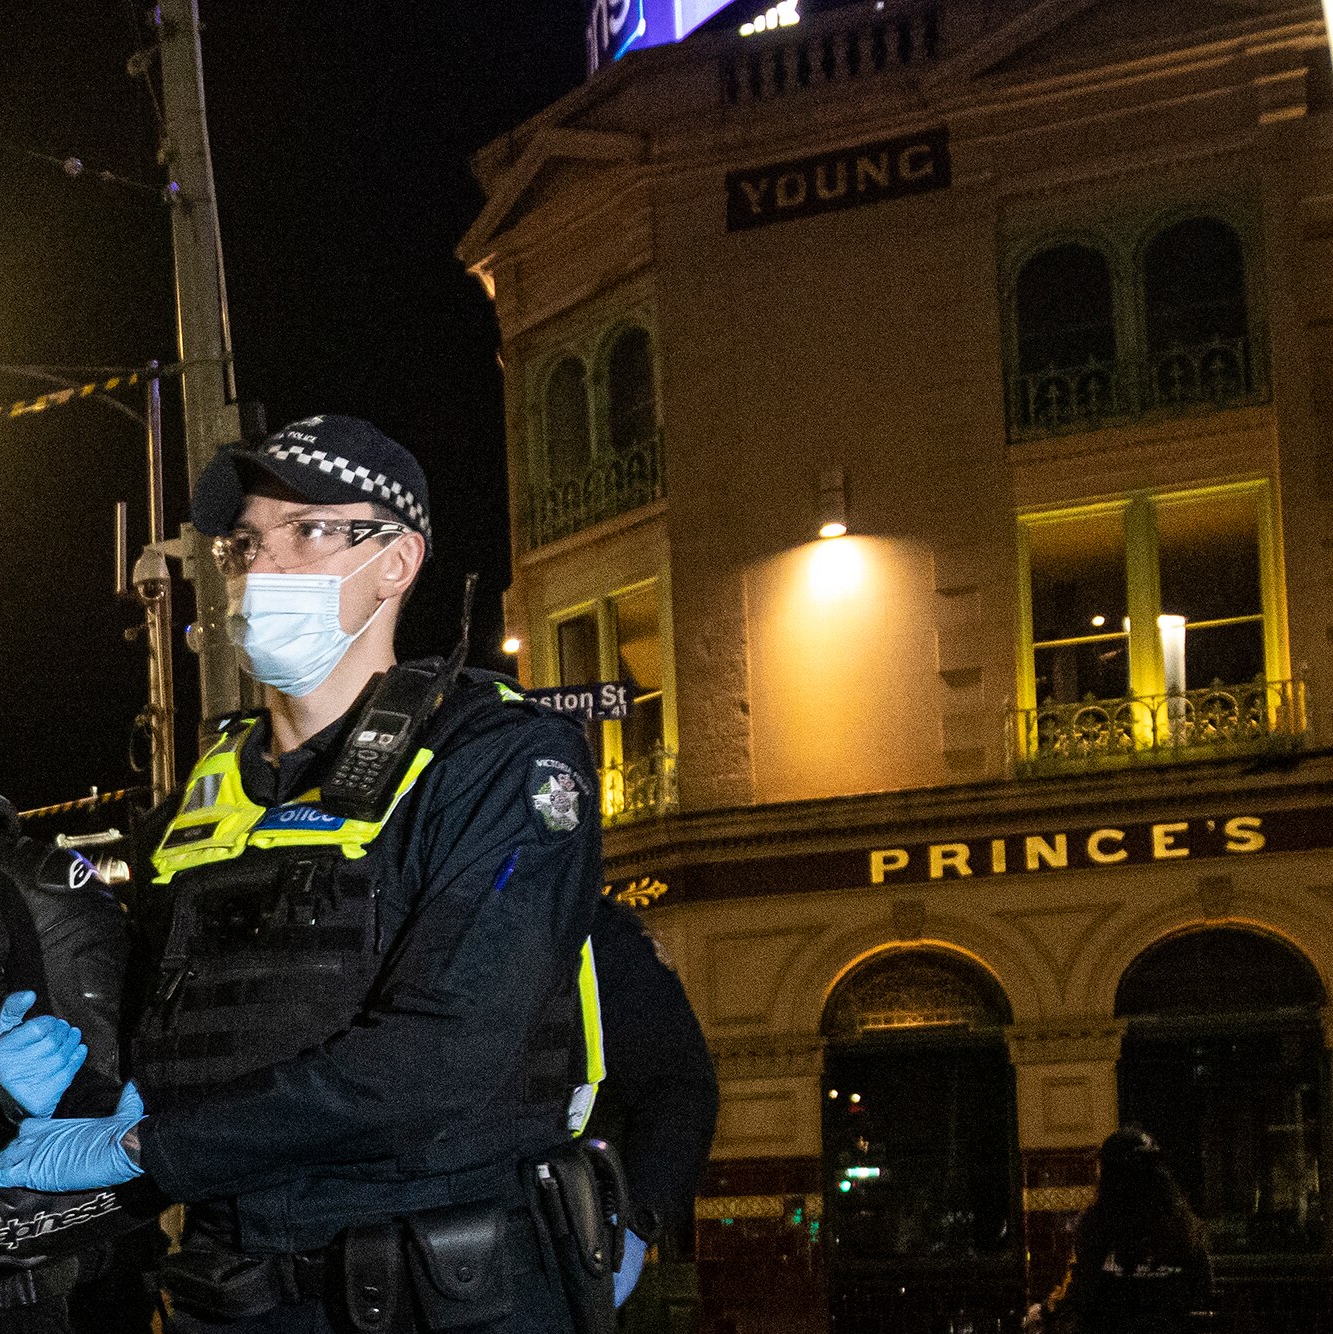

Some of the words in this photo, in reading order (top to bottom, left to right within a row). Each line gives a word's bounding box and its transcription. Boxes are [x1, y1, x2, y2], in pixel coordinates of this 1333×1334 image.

[740, 143, 935, 214] YOUNG
[526, 692, 593, 711] ston
[601, 684, 627, 706] St
[869, 816, 1266, 884] PRINCE'S
